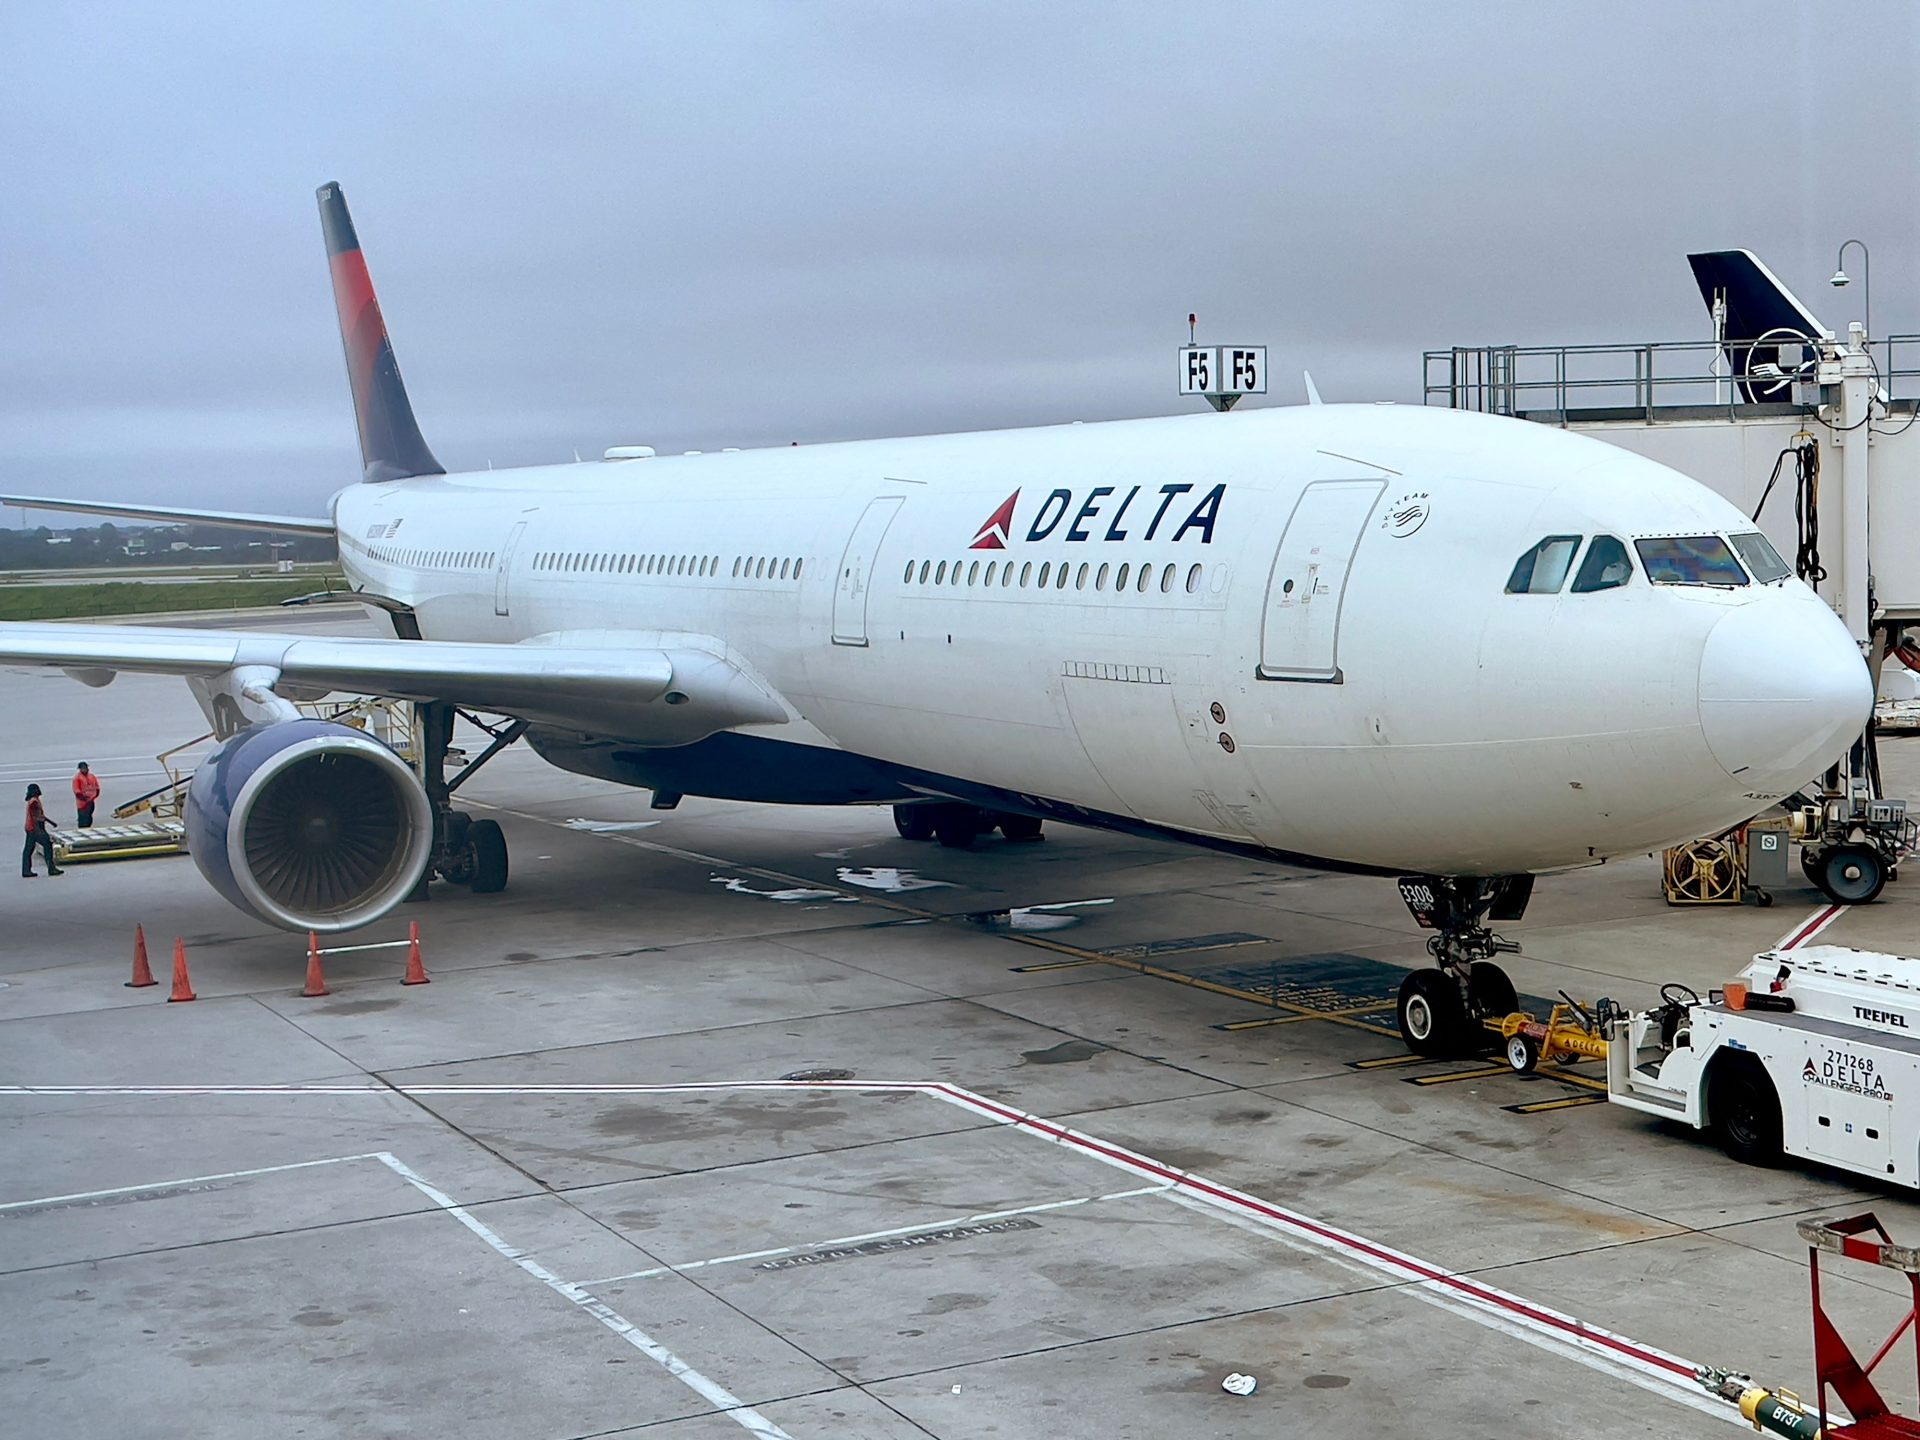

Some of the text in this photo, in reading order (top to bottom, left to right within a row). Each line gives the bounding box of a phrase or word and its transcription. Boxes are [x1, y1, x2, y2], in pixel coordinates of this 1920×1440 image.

[1188, 351, 1208, 391] F5
[1232, 351, 1256, 390] F5
[1025, 483, 1227, 544] DELTA
[1399, 884, 1434, 903] 3308
[1852, 1005, 1909, 1029] TREPEL
[1572, 1039, 1600, 1055] DELTA
[1827, 1049, 1874, 1072] 271268
[1802, 1073, 1883, 1099] CHALLENGER 280
[1823, 1061, 1885, 1091] DELTA
[1772, 1405, 1803, 1428] B737
